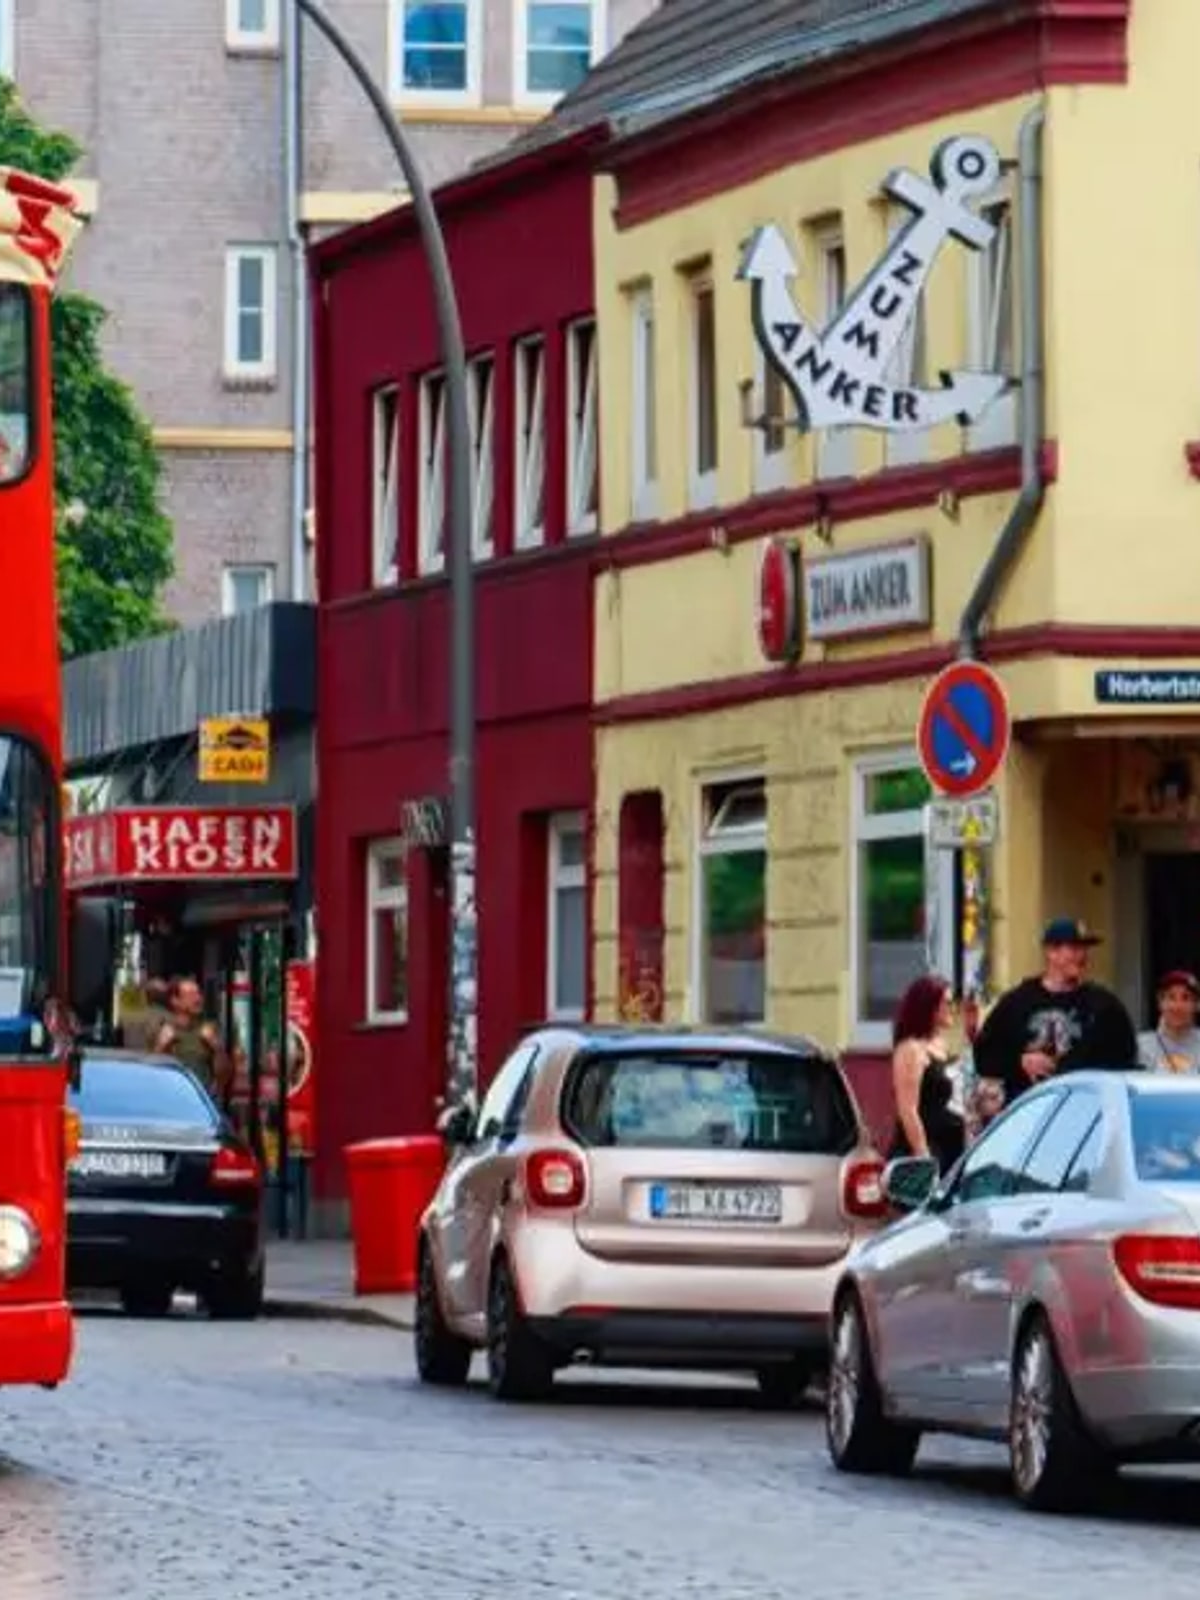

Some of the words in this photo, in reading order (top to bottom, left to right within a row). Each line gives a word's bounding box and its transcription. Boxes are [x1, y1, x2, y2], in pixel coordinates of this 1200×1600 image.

[841, 250, 921, 358] ZUM
[773, 322, 918, 421] ANKER
[810, 569, 848, 621] ZUM
[850, 562, 912, 613] ANKER
[129, 816, 281, 843] HAFEN
[135, 843, 279, 869] KIOSK
